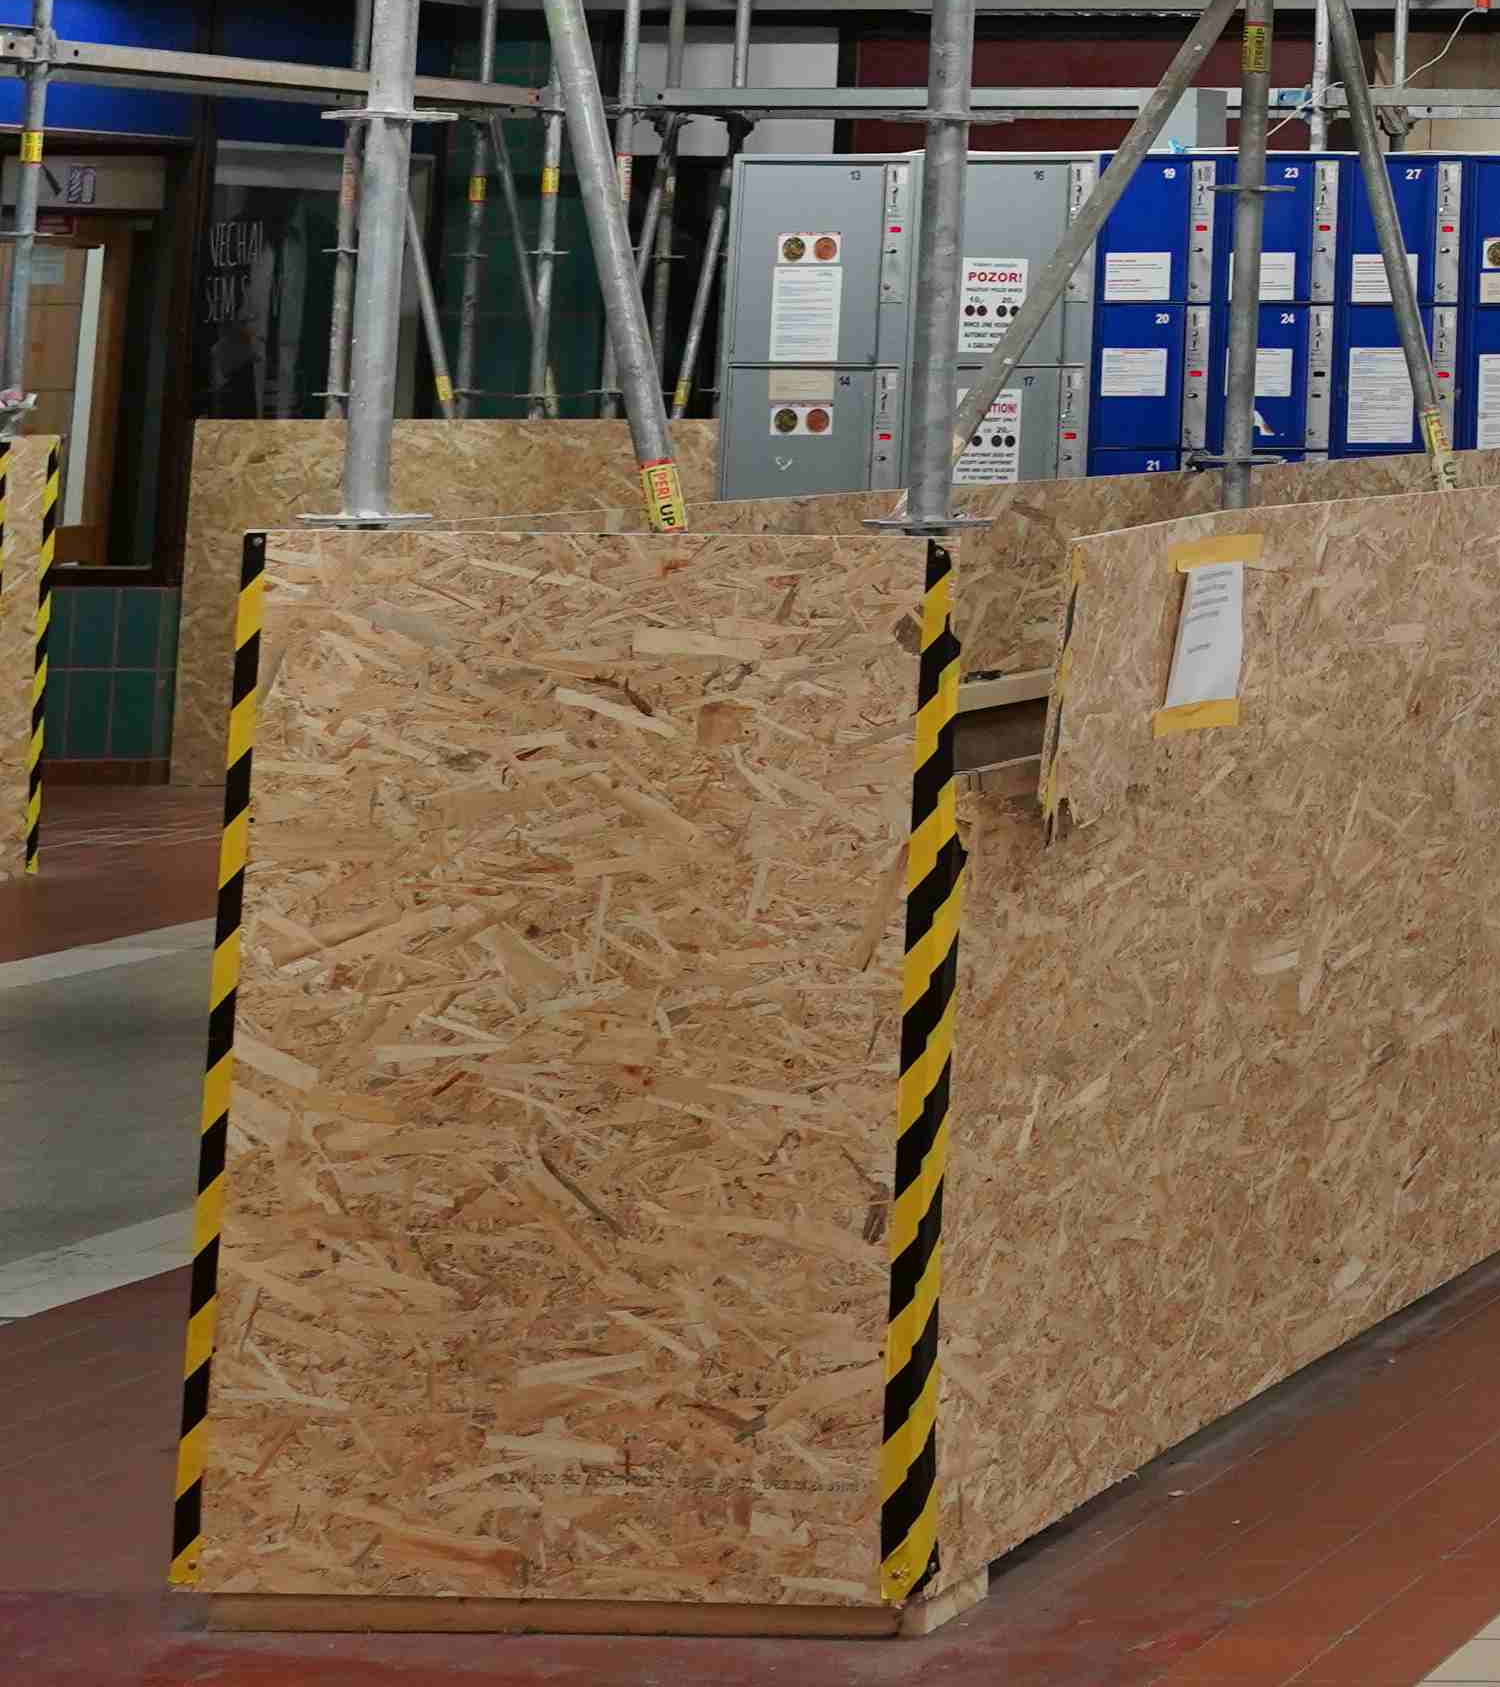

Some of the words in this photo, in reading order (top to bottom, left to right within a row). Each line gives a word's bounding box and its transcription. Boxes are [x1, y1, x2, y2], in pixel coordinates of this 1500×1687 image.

[1163, 168, 1176, 179] 19
[1284, 167, 1299, 179] 23
[1405, 168, 1422, 180] 27
[968, 271, 1023, 283] POZOR!
[1154, 313, 1170, 324] 20
[1280, 312, 1295, 324] 24
[1146, 460, 1160, 471] 21
[655, 470, 670, 502] PERI
[659, 502, 675, 528] UP
